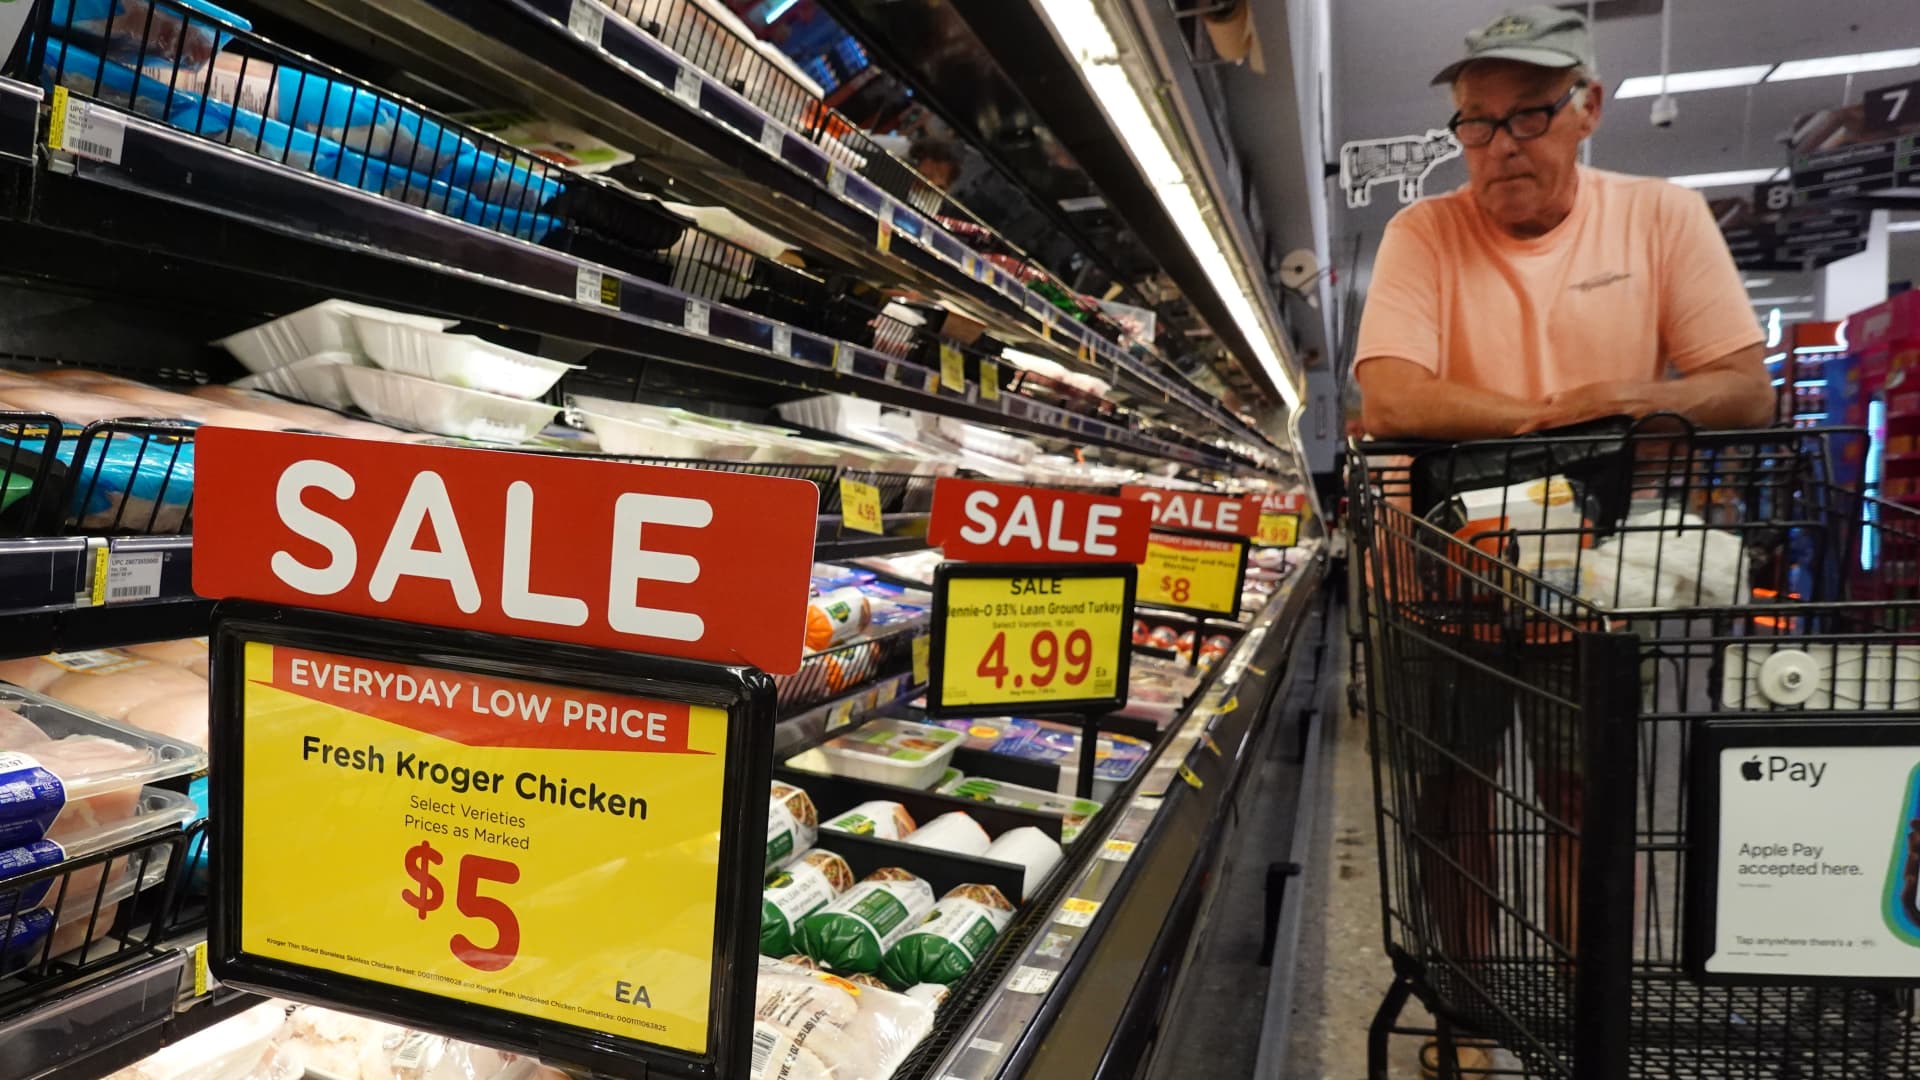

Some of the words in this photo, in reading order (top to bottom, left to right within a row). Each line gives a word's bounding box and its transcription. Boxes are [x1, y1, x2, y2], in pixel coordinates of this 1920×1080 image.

[1882, 89, 1909, 122] 7
[1767, 184, 1790, 210] 8
[1251, 495, 1296, 510] ALE
[960, 490, 1123, 557] SALE
[271, 459, 714, 643] SALE
[1010, 577, 1063, 596] SALE
[1161, 575, 1191, 603] $8
[947, 603, 992, 618] ennie-O
[995, 603, 1018, 616] 93%
[1020, 602, 1045, 616] Lean
[1048, 601, 1085, 615] Ground
[1088, 601, 1122, 616] Turkey
[976, 628, 1093, 689] 4.99
[291, 658, 462, 711] EVERYDAY
[472, 686, 552, 724] LOW
[563, 700, 668, 743] PRICE
[303, 735, 385, 775] Fresh
[396, 750, 504, 794] Kroger
[515, 771, 648, 821] Chicken
[1767, 755, 1828, 788] Pay
[410, 795, 456, 816] Select
[460, 803, 526, 829] Verieties
[404, 814, 449, 835] Prices
[453, 826, 469, 839] as
[474, 827, 530, 850] Marked
[1738, 842, 1788, 859] Apple
[1792, 842, 1824, 860] Pay
[1738, 861, 1818, 878] accepted
[1821, 862, 1865, 877] here.
[402, 839, 520, 972] $5
[1736, 935, 1755, 947] Tap
[1756, 936, 1808, 948] anywhere
[1808, 937, 1845, 948] there's
[1845, 939, 1854, 948] a
[266, 937, 286, 947] Kroger
[287, 941, 300, 951] Thin
[301, 944, 319, 954] Sliced
[346, 954, 370, 966] Skinless
[371, 960, 395, 971] Chicken
[476, 983, 498, 994] Kroger
[498, 988, 516, 999] Fresh
[517, 992, 550, 1006] Uncooked
[550, 999, 577, 1012] Chicken
[577, 1006, 614, 1021] Drumsticks:
[615, 980, 652, 1009] EA
